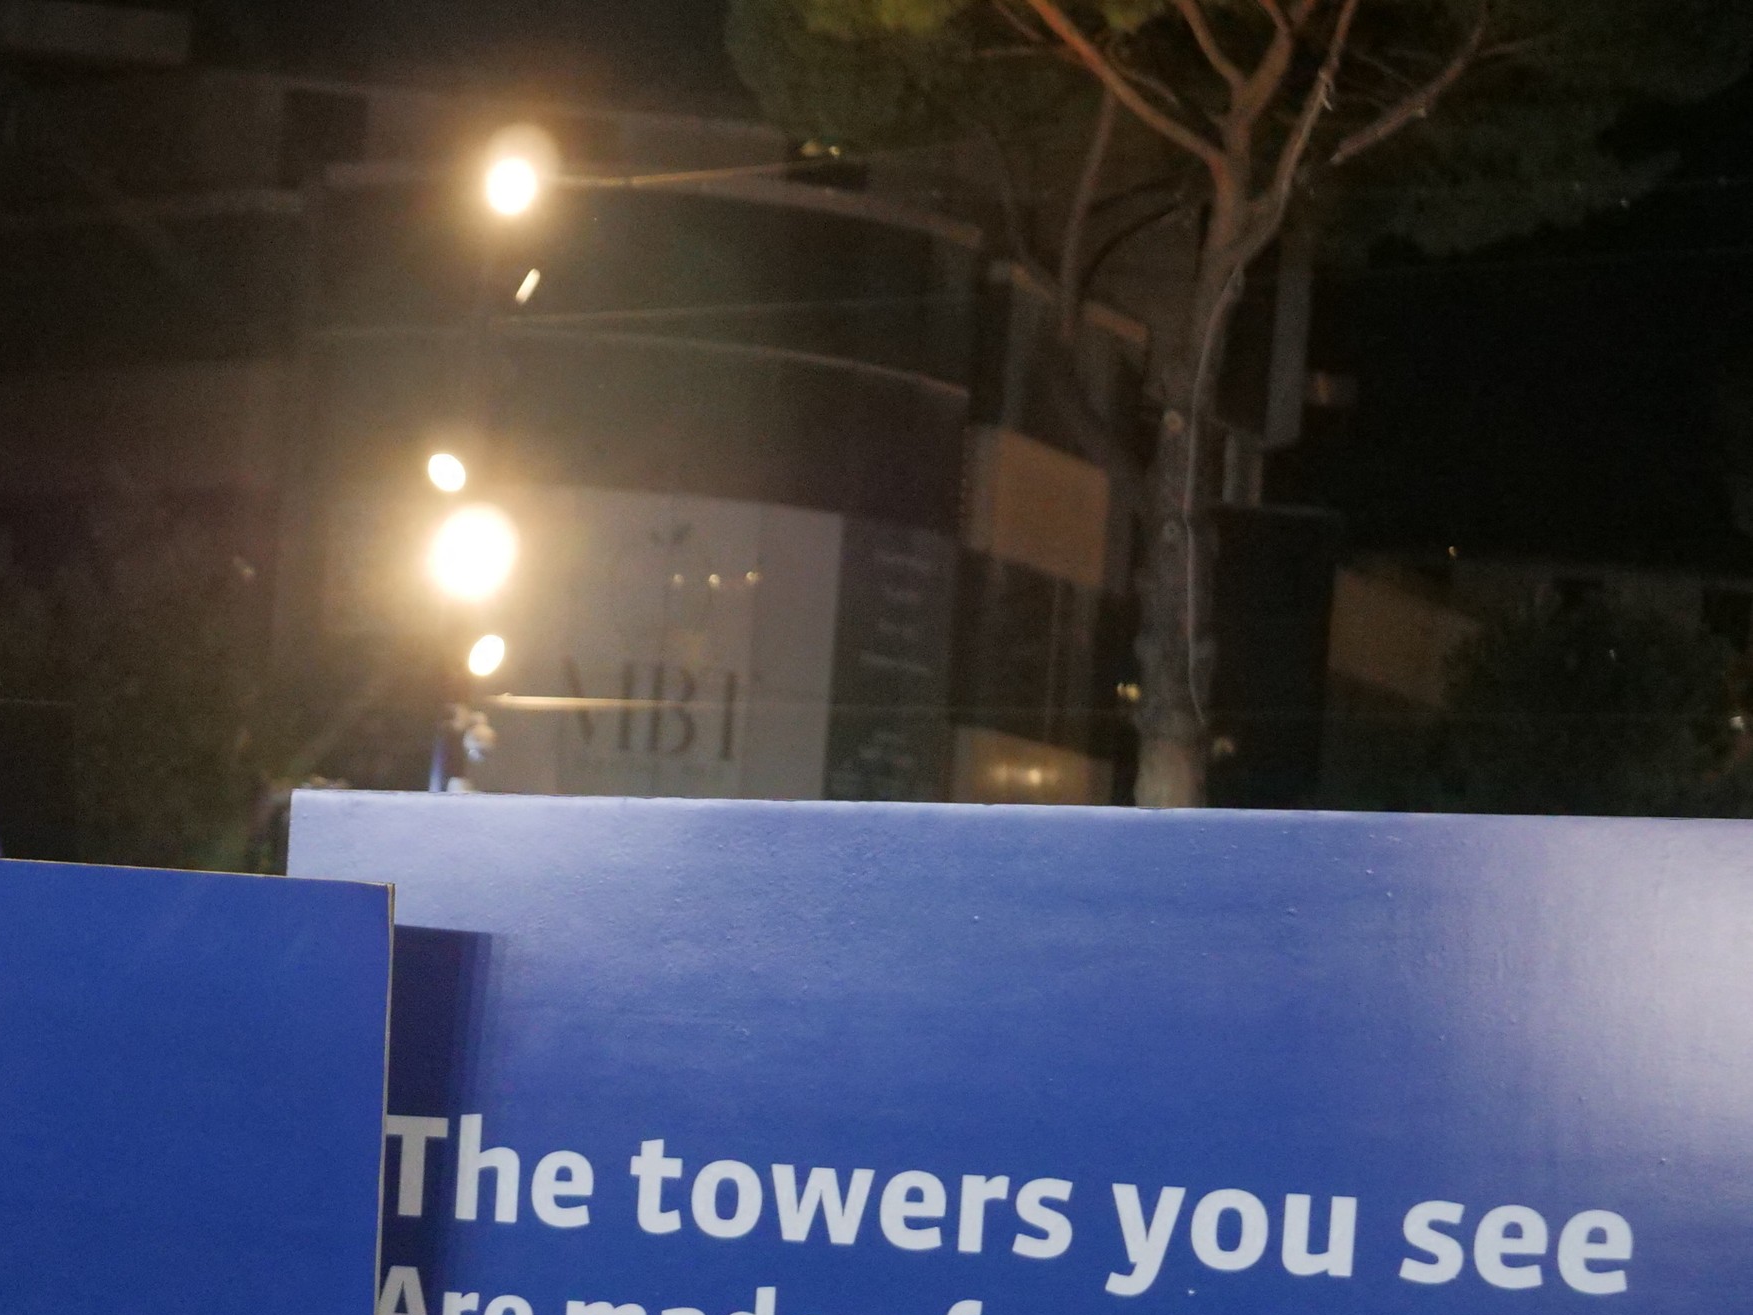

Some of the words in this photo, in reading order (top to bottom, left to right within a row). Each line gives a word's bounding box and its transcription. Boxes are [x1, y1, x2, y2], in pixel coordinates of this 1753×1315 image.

[384, 1112, 595, 1230] The
[629, 1138, 1074, 1260] towers
[1105, 1183, 1359, 1298] you
[1398, 1200, 1635, 1296] see
